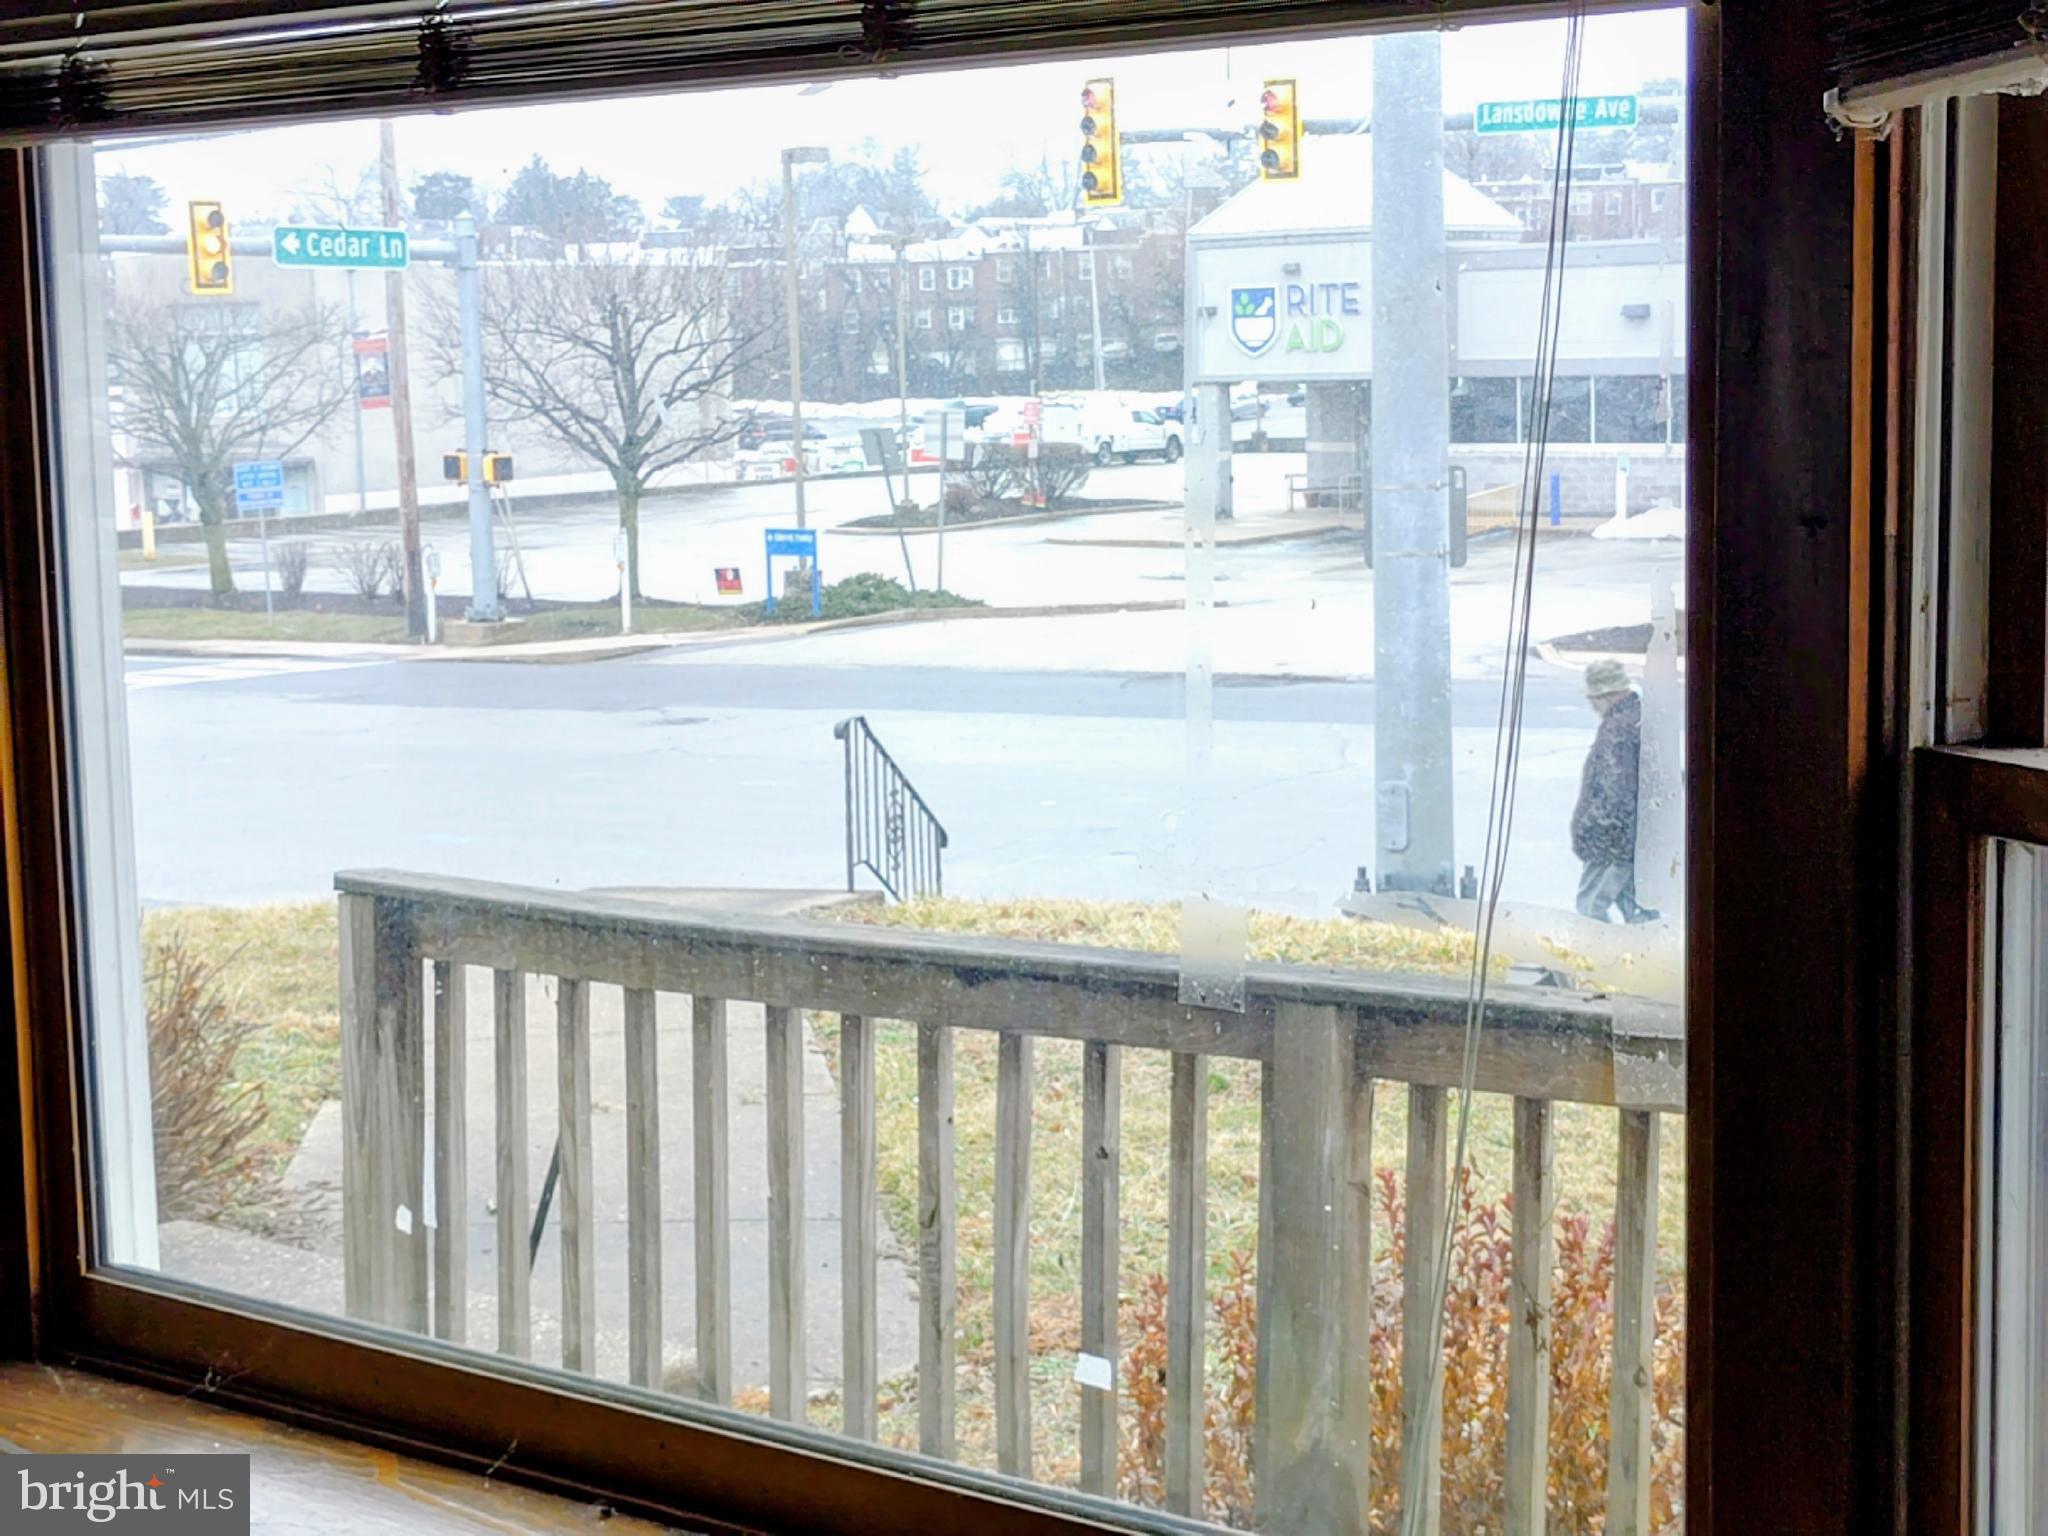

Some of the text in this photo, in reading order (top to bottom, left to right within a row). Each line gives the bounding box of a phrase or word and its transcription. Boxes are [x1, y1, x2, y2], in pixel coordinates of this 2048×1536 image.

[1482, 99, 1629, 124] Lansdowe Ave
[306, 232, 402, 259] Cedar Ln
[1287, 283, 1360, 316] RITE
[1286, 319, 1344, 354] AID
